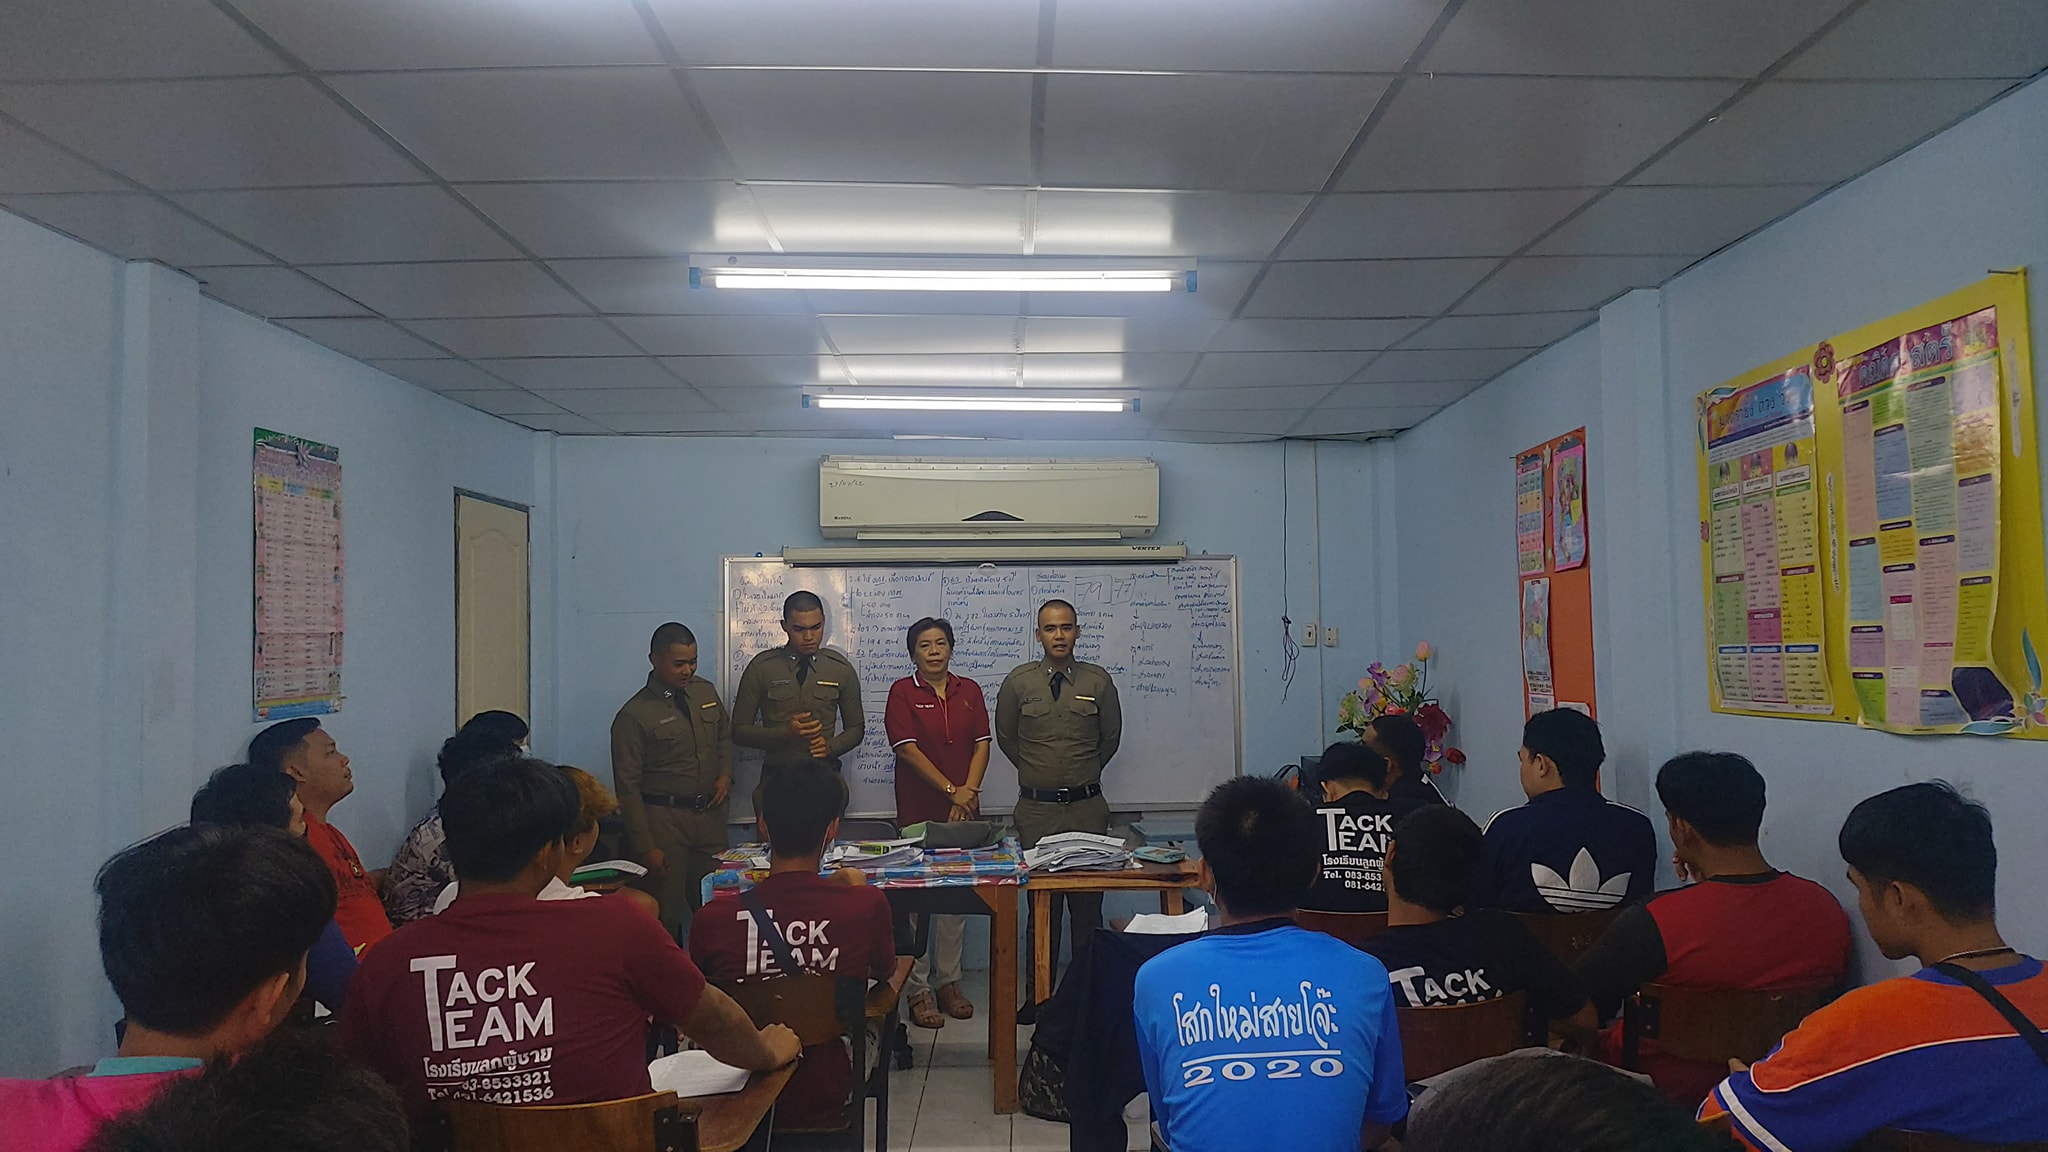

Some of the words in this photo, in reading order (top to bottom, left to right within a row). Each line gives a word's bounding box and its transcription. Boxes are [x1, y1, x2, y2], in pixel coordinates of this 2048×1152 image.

[1859, 321, 1953, 387] คณิตศสตร์
[1316, 808, 1394, 852] TACK
[1322, 853, 1384, 870] โรงเรียนลูกผู้
[1323, 870, 1342, 879] Tel.
[1344, 870, 1382, 881] 083-853
[410, 955, 537, 1051] TACK
[1388, 966, 1491, 1008] TACK
[423, 1047, 553, 1078] โรงเรียนลกผู้ชาย
[1183, 1057, 1344, 1088] 2020
